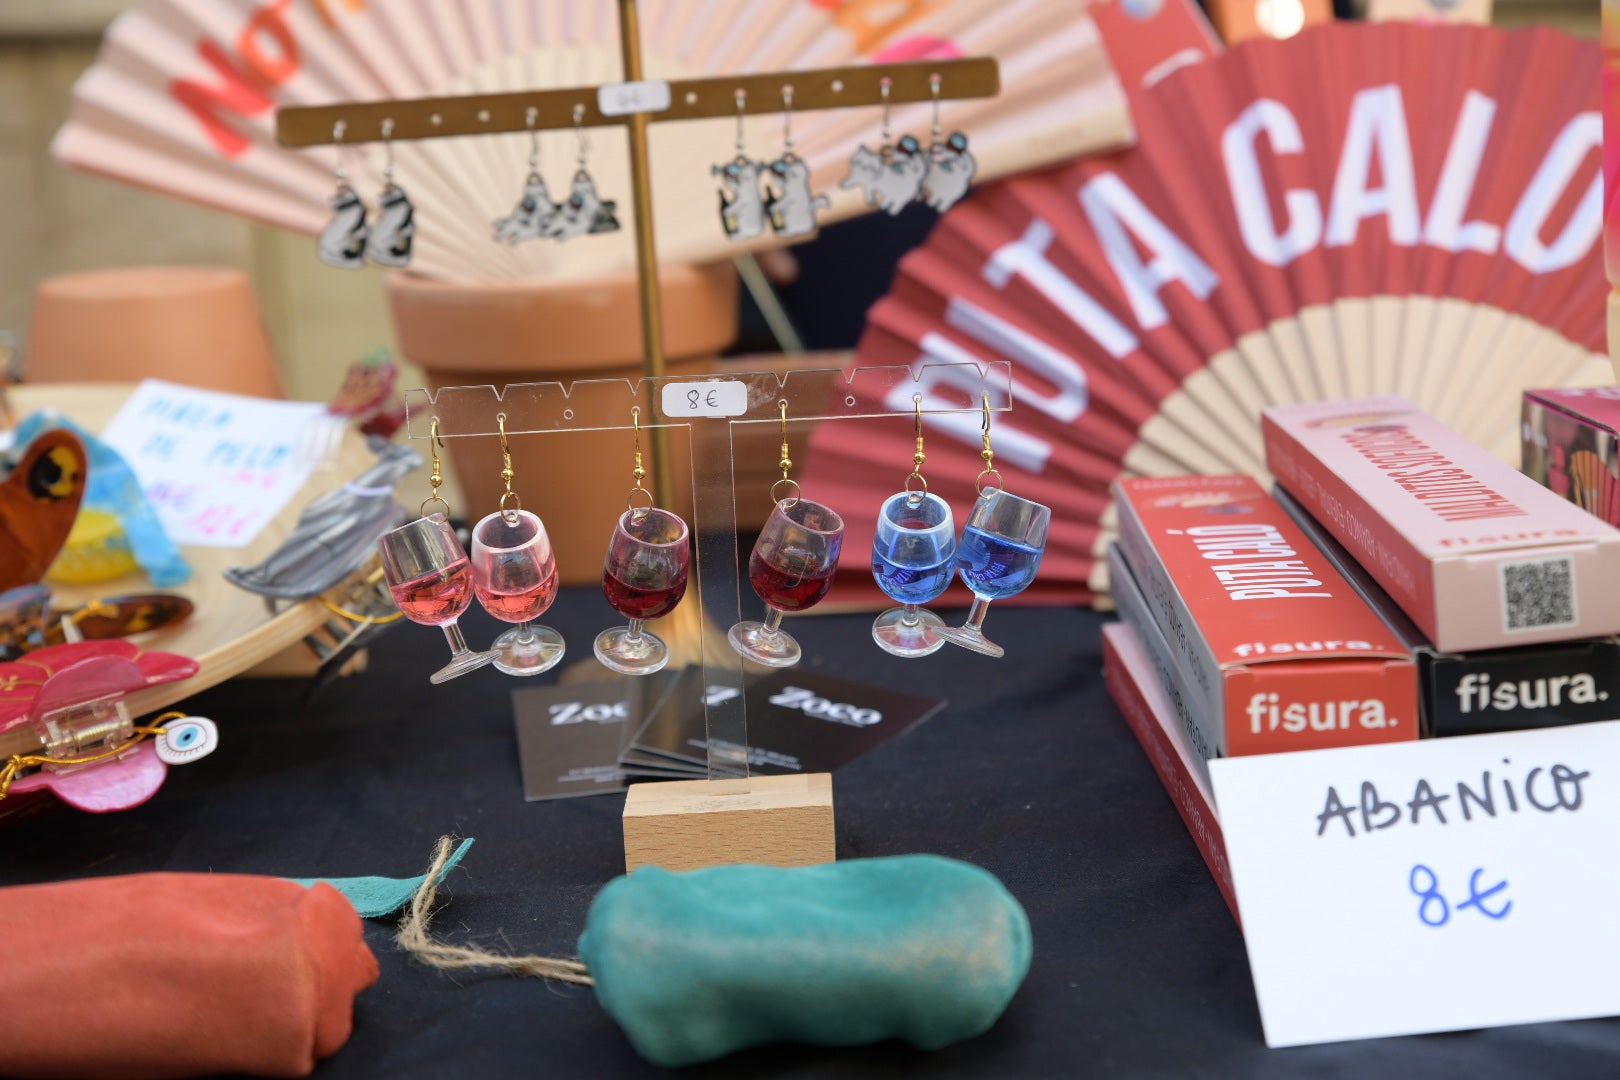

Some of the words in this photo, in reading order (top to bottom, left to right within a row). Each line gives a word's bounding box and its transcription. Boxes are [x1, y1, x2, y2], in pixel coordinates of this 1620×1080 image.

[885, 170, 1221, 474] PUTA
[686, 388, 720, 410] 8€
[1387, 468, 1530, 522] MALDITOS
[1166, 523, 1297, 560] CALÓ
[1210, 560, 1333, 601] PUTA
[1232, 640, 1385, 657] fisura.
[769, 686, 883, 726] Zoco
[1455, 673, 1609, 713] fisura.
[1246, 693, 1399, 734] fisura.
[1409, 864, 1513, 927] 8€
